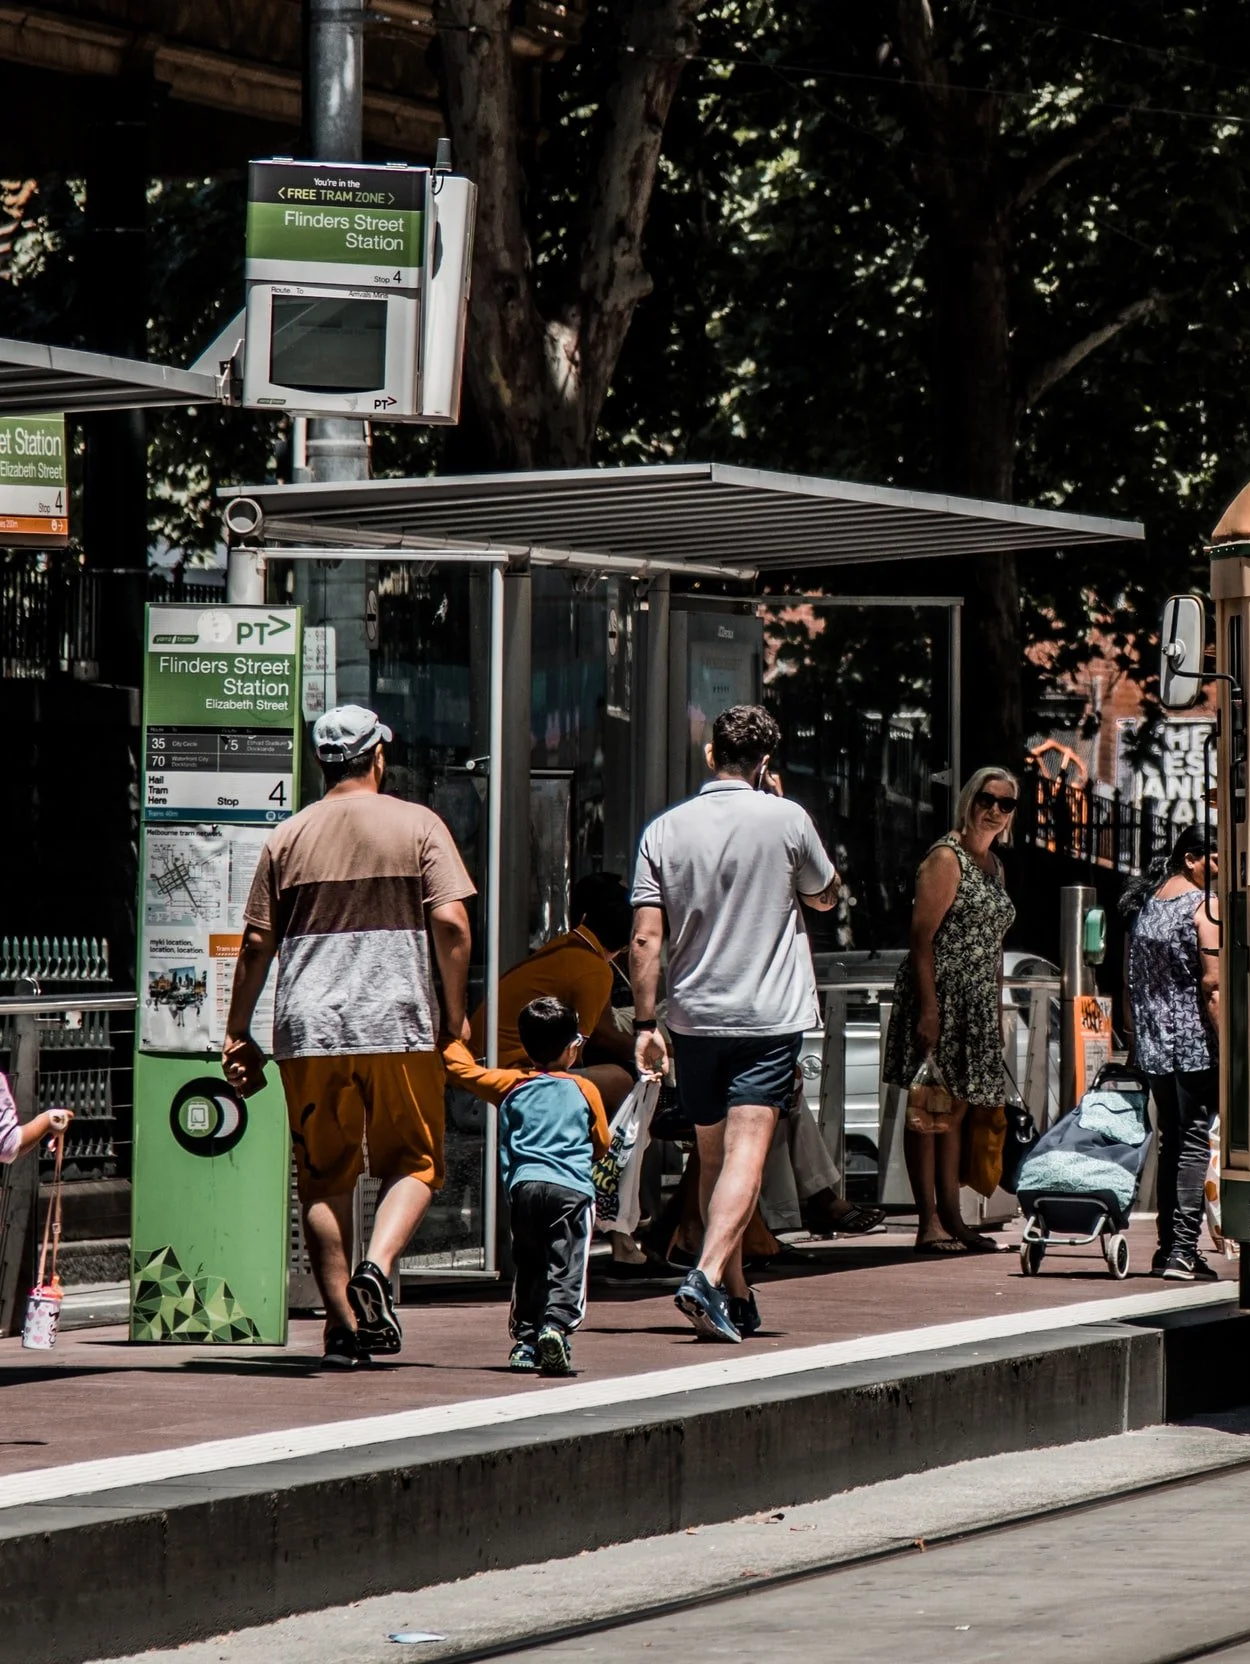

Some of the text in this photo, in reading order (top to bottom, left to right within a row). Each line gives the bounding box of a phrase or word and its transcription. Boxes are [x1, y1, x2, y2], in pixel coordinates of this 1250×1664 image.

[314, 178, 360, 188] You're in the
[287, 188, 385, 204] FREE TRAM ZONE
[285, 210, 404, 232] Flinders Street
[346, 232, 404, 250] Station
[374, 270, 402, 284] Stop 4
[271, 286, 304, 295] Route To
[14, 428, 62, 456] Station
[0, 461, 62, 479] Elizabeth Street
[39, 490, 62, 514] Stop 4
[160, 656, 290, 675] Flinders Street
[224, 678, 289, 696] Station
[206, 698, 288, 711] Elizabeth Street
[152, 738, 166, 749] 35
[152, 756, 166, 767] 70
[148, 776, 164, 784] Hail
[148, 786, 168, 794] Tram
[217, 780, 287, 808] Stop 4
[148, 796, 168, 804] Here
[150, 939, 165, 947] myki
